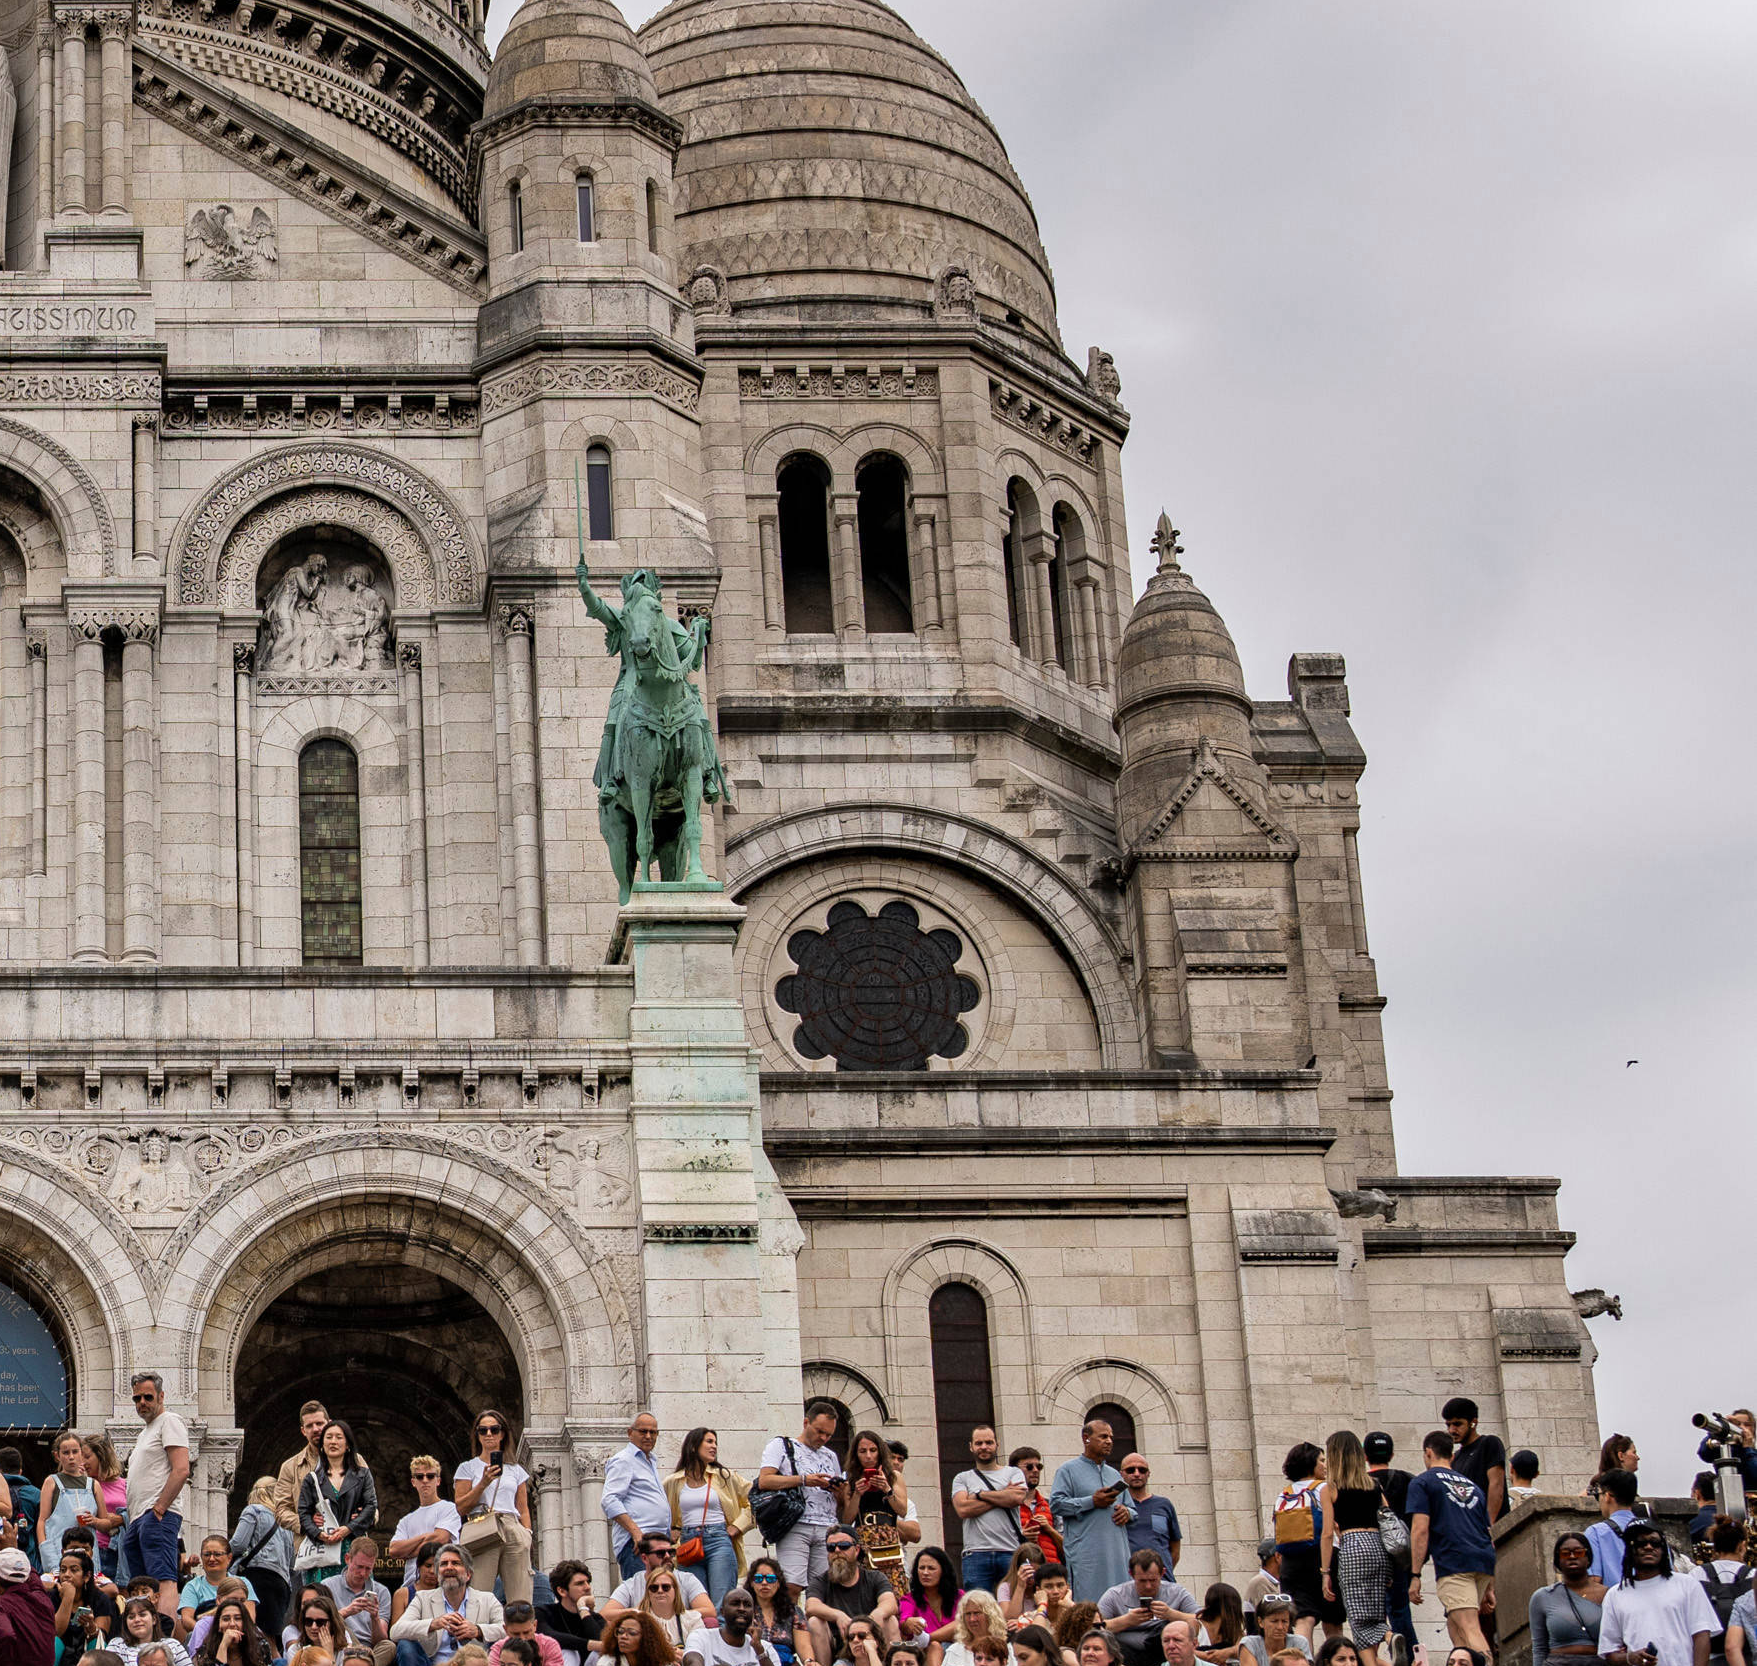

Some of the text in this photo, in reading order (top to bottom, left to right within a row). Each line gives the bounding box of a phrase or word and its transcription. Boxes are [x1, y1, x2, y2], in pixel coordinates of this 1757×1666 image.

[0, 1370, 19, 1382] day,
[0, 1383, 15, 1392] has
[1, 1395, 16, 1404] the
